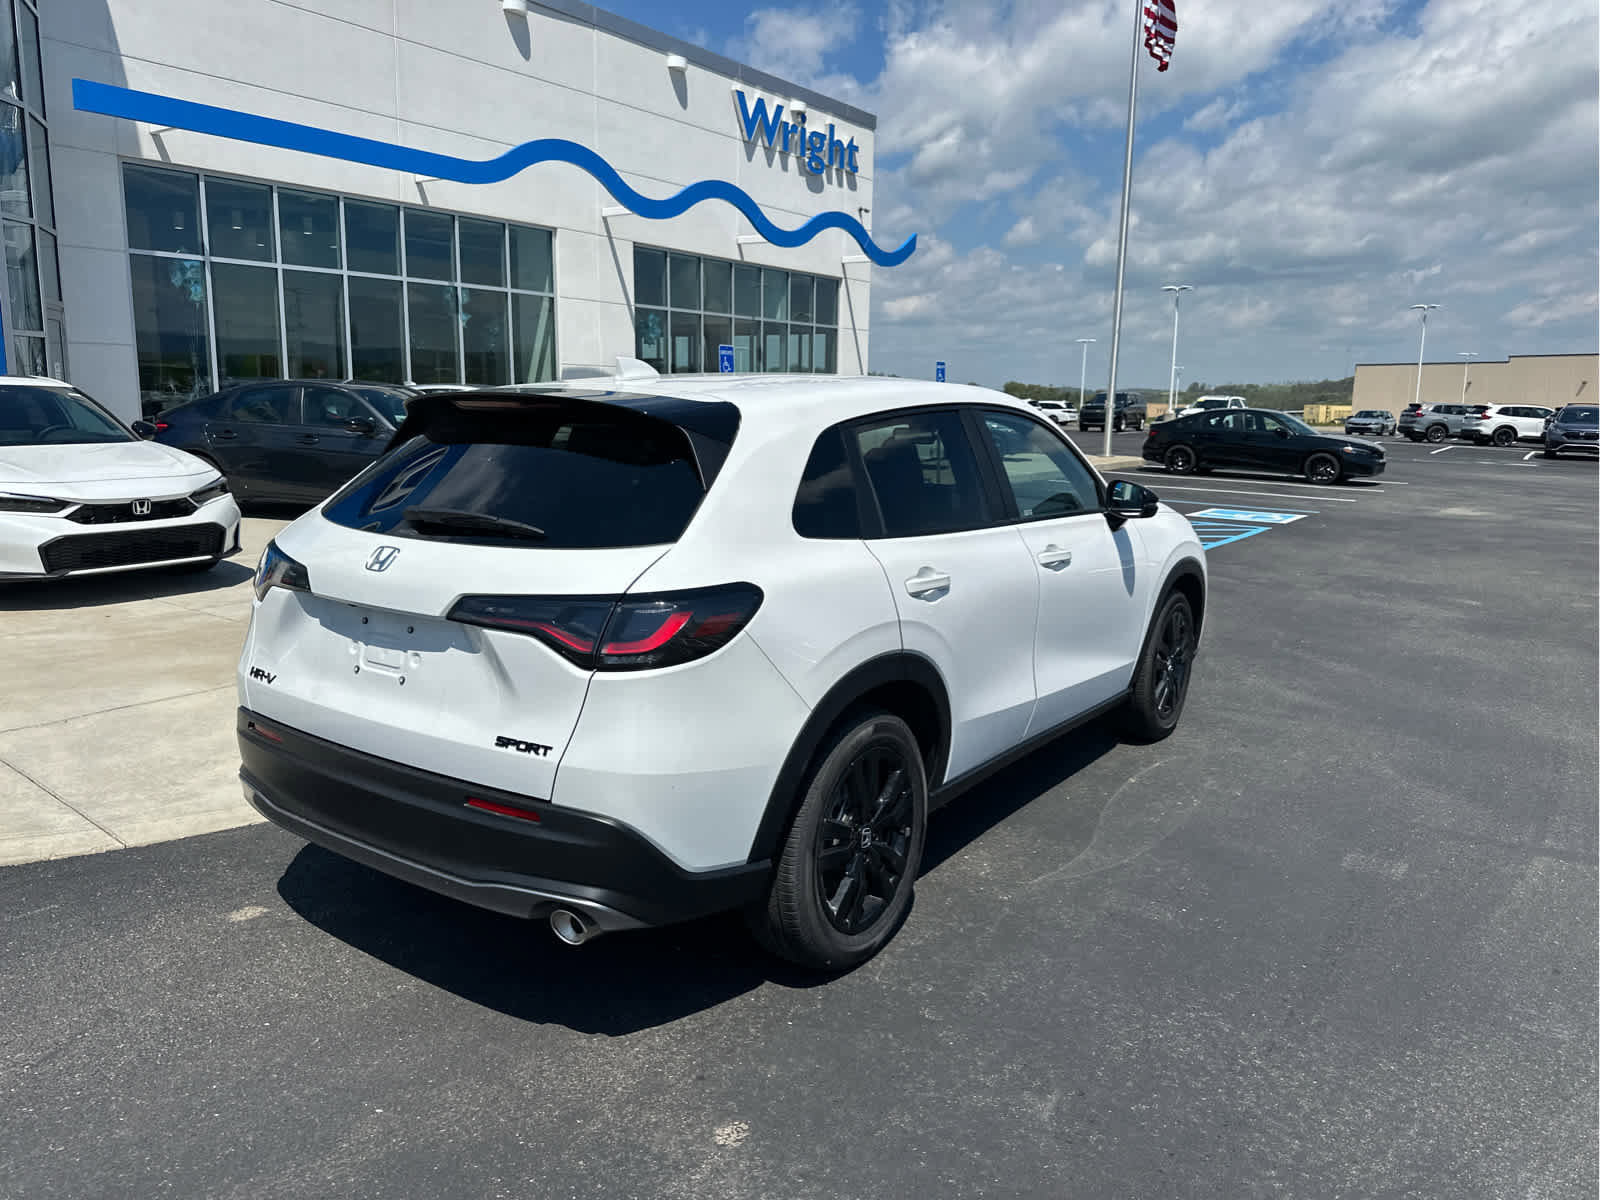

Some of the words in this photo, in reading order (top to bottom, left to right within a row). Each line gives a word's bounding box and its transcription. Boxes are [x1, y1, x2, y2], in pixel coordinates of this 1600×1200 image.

[735, 89, 859, 175] Wright
[250, 666, 277, 684] HR-V
[495, 736, 553, 757] SPORT
